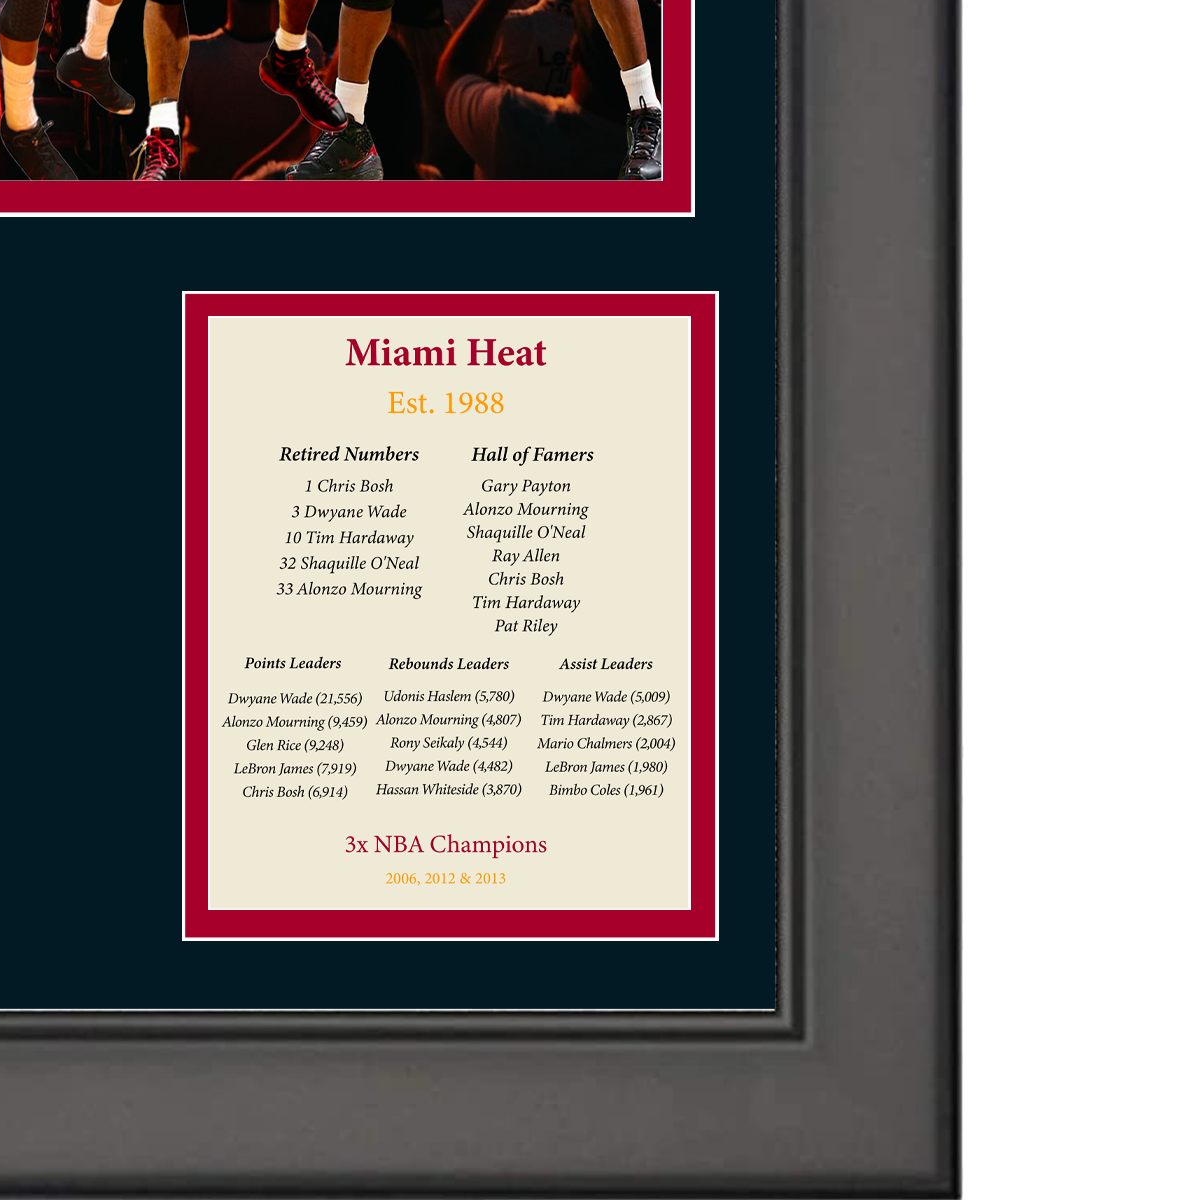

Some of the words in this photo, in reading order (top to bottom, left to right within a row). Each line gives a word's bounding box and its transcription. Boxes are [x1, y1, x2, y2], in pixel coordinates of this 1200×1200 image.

[345, 338, 457, 366] Miami
[467, 339, 546, 366] Heat
[388, 392, 434, 413] Est.
[445, 392, 504, 413] 1988
[279, 446, 340, 461] Retired
[344, 446, 419, 461] Numbers
[471, 446, 508, 461] Hall
[513, 446, 531, 466] of
[532, 447, 594, 461] Famers
[305, 480, 311, 492] 1
[318, 479, 355, 492] Chris
[360, 479, 393, 492] Bosh
[482, 479, 518, 496] Gary
[522, 479, 571, 496] Payton
[292, 506, 299, 518] 3
[304, 505, 363, 522] Dwyane
[368, 504, 407, 518] Wade
[462, 502, 513, 515] Alonzo
[517, 503, 589, 520] Mourning
[285, 531, 301, 544] 10
[306, 531, 334, 544] Tim
[339, 530, 414, 548] Hardaway
[467, 525, 533, 543] Shaquille
[538, 525, 586, 539] O'Neal
[279, 557, 296, 569] 32
[301, 556, 366, 574] Shaquille
[371, 556, 419, 569] O'Neal
[492, 549, 520, 566] Ray
[522, 548, 559, 562] Allen
[489, 572, 526, 585] Chris
[530, 572, 563, 585] Bosh
[276, 583, 293, 595] 33
[296, 581, 346, 595] Alonzo
[351, 582, 423, 599] Mourning
[473, 596, 501, 608] Tim
[505, 595, 580, 613] Hardaway
[495, 619, 519, 632] Pat
[522, 618, 558, 636] Riley
[244, 657, 286, 669] Points
[289, 656, 341, 669] Leaders
[388, 657, 454, 670] Rebounds
[457, 657, 509, 670] Leaders
[559, 658, 597, 670] Assist
[600, 657, 653, 670] Leaders
[228, 693, 277, 707] Dwyane
[280, 692, 312, 704] Wade
[316, 692, 362, 706] (21,556)
[385, 690, 424, 702] Udonis
[427, 690, 471, 702] Haslem
[475, 690, 515, 704] (5,780)
[542, 691, 591, 706] Dwyane
[595, 690, 627, 702] Wade
[631, 690, 670, 705] (5,009)
[221, 715, 263, 727] Alonzo
[266, 716, 325, 731] Mourning
[328, 715, 367, 730] (9,459)
[376, 713, 417, 725] Alonzo
[420, 714, 479, 729] Mourning
[482, 713, 521, 727] (4,807)
[541, 714, 564, 725] Tim
[568, 714, 630, 729] Hardaway
[633, 713, 672, 728] (2,867)
[247, 739, 273, 751] Glen
[277, 740, 301, 751] Rice
[304, 739, 344, 753] (9,248)
[390, 737, 420, 752] Rony
[423, 736, 464, 752] Seikaly
[468, 736, 507, 751] (4,544)
[537, 738, 574, 749] Mario
[577, 737, 632, 749] Chalmers
[636, 737, 675, 751] (2,004)
[234, 763, 276, 774] LeBron
[278, 763, 313, 776] James
[317, 762, 356, 776] (7,919)
[385, 760, 434, 775] Dwyane
[437, 760, 470, 771] Wade
[473, 759, 513, 774] (4,482)
[545, 761, 587, 772] LeBron
[590, 761, 625, 774] James
[628, 760, 667, 775] (1,980)
[243, 786, 274, 797] Chris
[276, 785, 304, 797] Bosh
[308, 785, 348, 800] (6,914)
[376, 784, 419, 795] Hassan
[422, 783, 479, 795] Whiteside
[482, 783, 522, 797] (3,870)
[549, 784, 587, 795] Bimbo
[591, 784, 621, 796] Coles
[624, 783, 664, 798] (1,961)
[346, 836, 368, 853] 3x
[374, 835, 424, 853] NBA
[430, 834, 547, 859] Champions
[386, 873, 420, 885] 2006,
[425, 873, 455, 884] 2012
[460, 873, 471, 884] &
[476, 873, 505, 884] 2013
